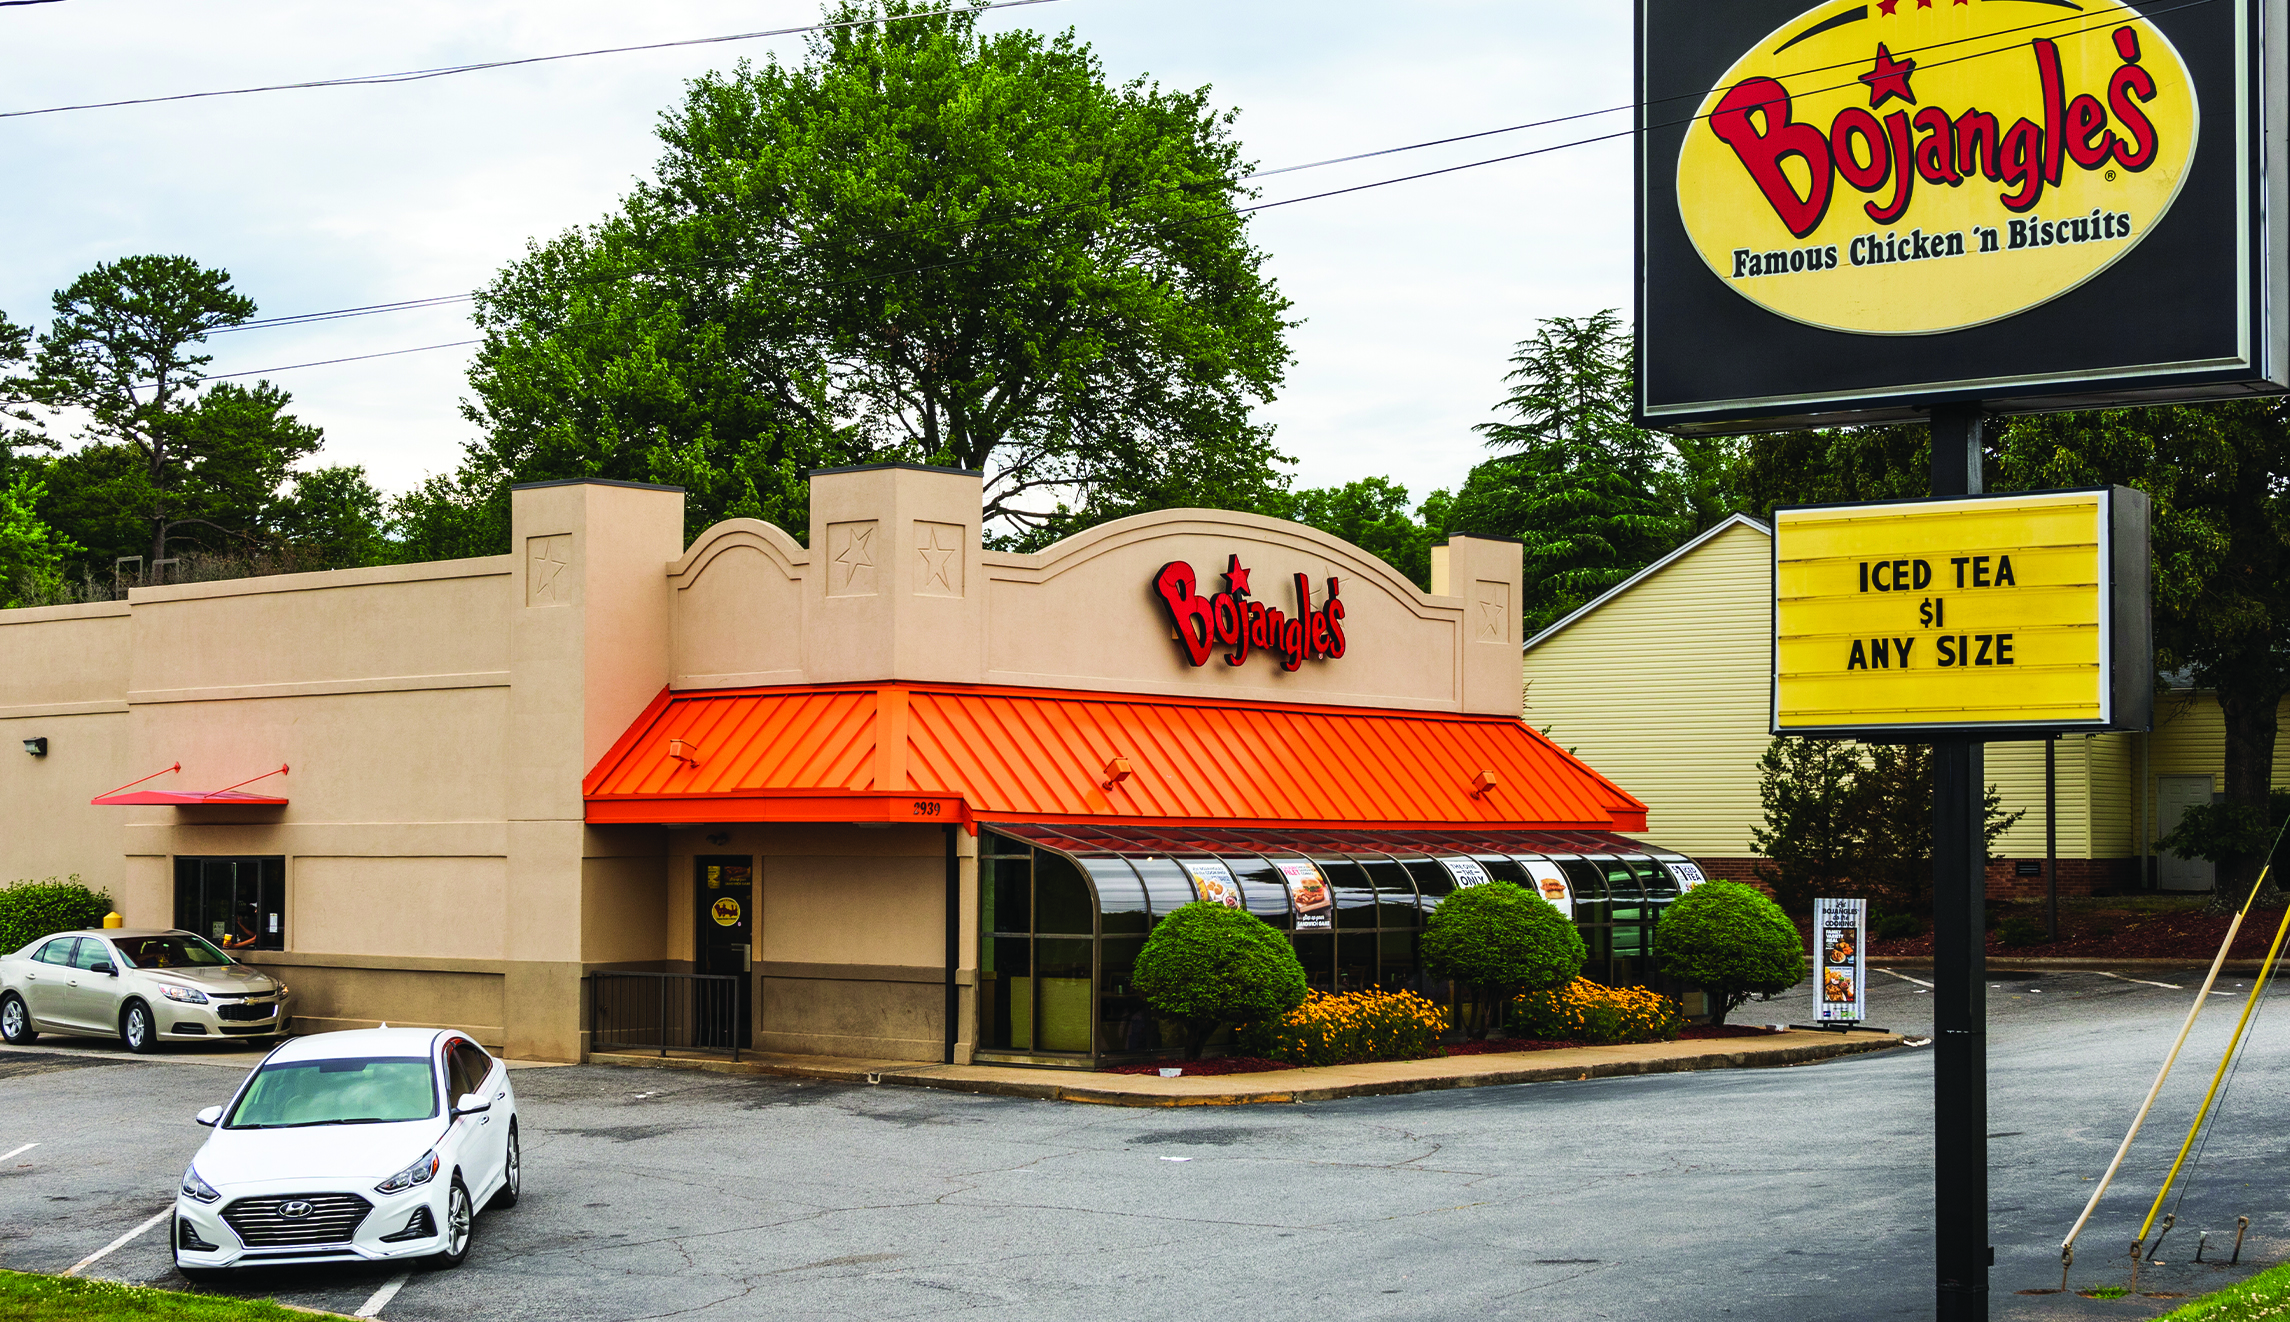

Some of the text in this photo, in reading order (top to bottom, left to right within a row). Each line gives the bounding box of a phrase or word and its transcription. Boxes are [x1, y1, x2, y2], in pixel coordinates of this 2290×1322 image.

[1732, 246, 1838, 278] Famous
[1849, 229, 1965, 266] Chicken
[2008, 207, 2131, 248] Biscuits
[1859, 555, 2016, 592] ICED TEA
[1919, 597, 1944, 628] $1
[1847, 633, 2014, 670] ANY SIZE
[913, 801, 941, 816] 2939
[1687, 873, 1702, 881] TEA
